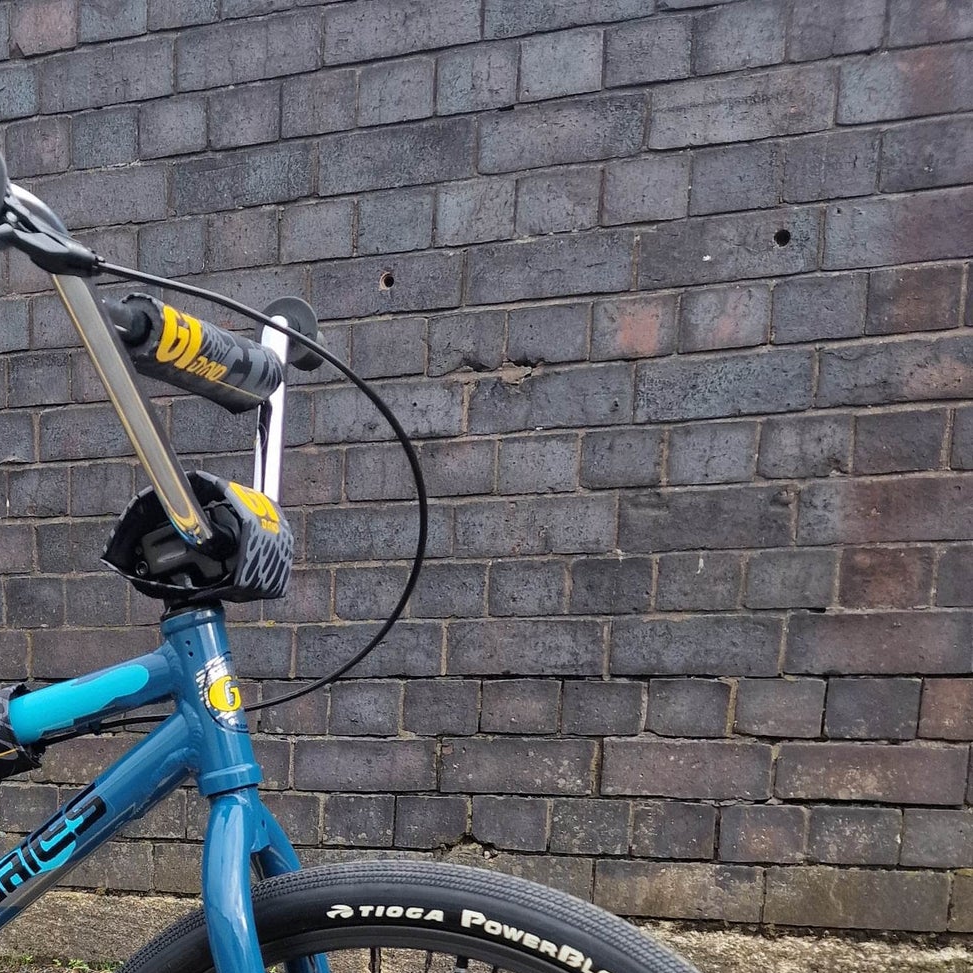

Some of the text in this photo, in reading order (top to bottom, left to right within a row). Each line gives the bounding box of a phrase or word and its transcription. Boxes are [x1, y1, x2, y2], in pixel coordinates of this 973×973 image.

[155, 304, 203, 369] GT
[208, 675, 242, 712] G
[359, 905, 444, 922] TIOGA
